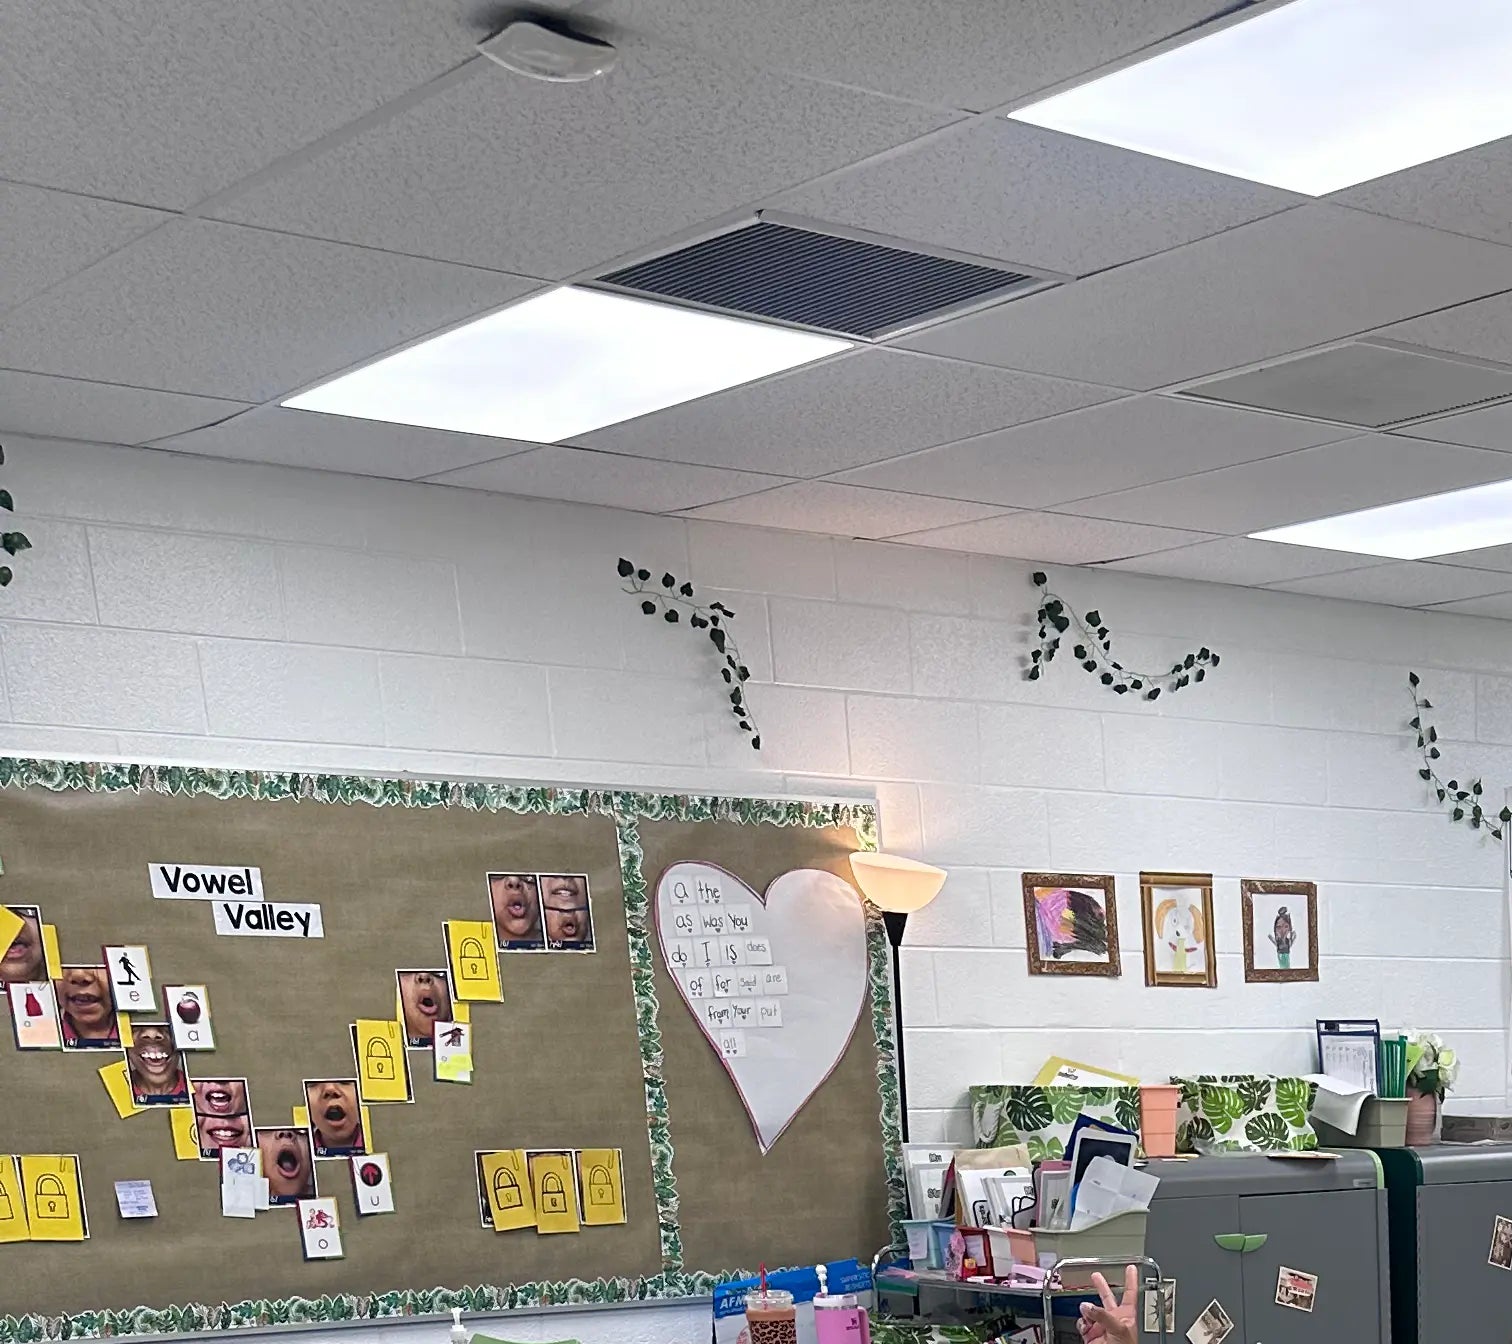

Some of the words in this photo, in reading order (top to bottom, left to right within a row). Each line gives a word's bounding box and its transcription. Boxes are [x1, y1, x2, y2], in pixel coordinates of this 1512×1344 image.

[160, 866, 253, 895] Vowel
[698, 880, 721, 900] the
[223, 903, 310, 938] Valley
[676, 914, 693, 928] as
[671, 945, 688, 962] do
[701, 941, 711, 963] I
[690, 976, 703, 992] of
[715, 975, 731, 991] for
[766, 974, 782, 983] are
[129, 991, 140, 1001] e
[708, 1006, 729, 1021] from
[760, 1005, 777, 1020] put
[188, 1030, 199, 1042] a
[723, 1035, 736, 1049] all
[720, 1295, 746, 1310] AFM
